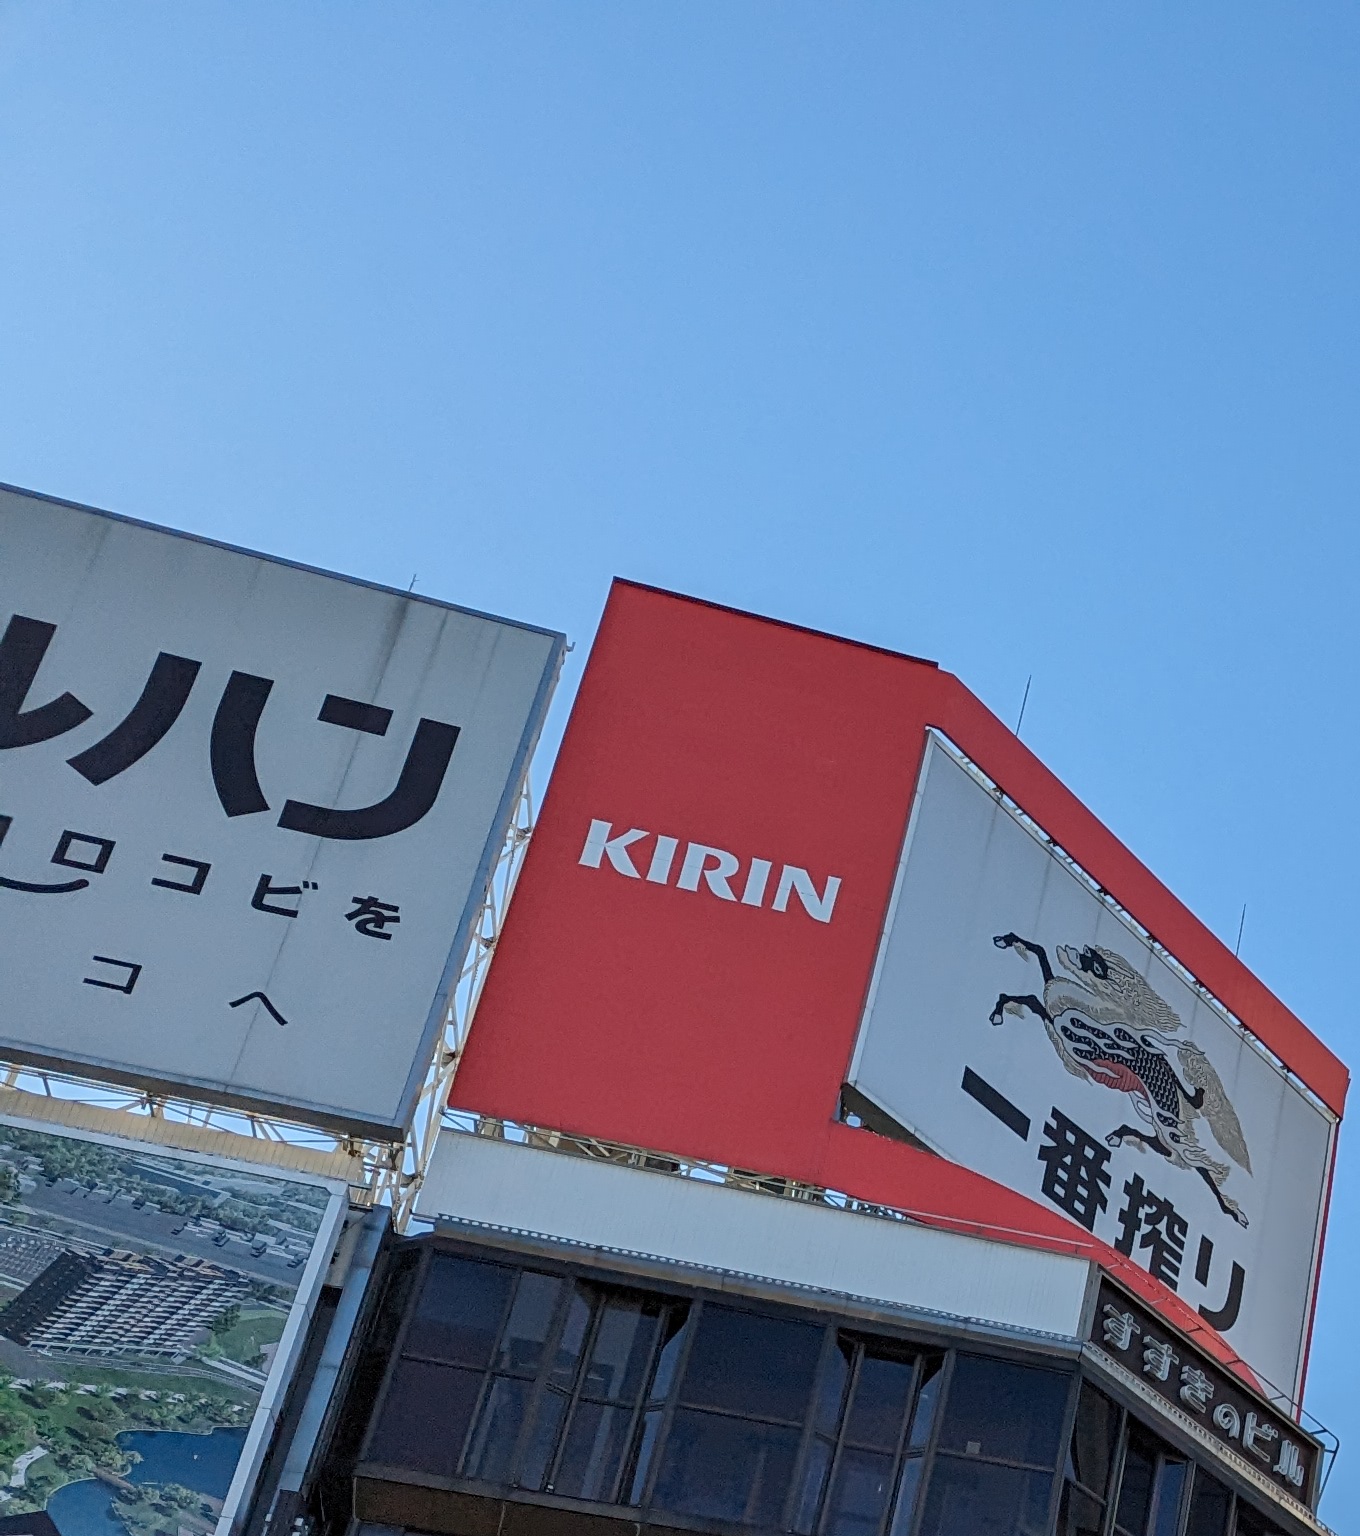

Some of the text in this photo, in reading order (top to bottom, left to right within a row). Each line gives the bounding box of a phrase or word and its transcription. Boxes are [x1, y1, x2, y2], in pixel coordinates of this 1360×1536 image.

[578, 819, 842, 924] KIRIN
[961, 1065, 1246, 1332] 一番搾り
[1103, 1303, 1305, 1487] すすきのビル
